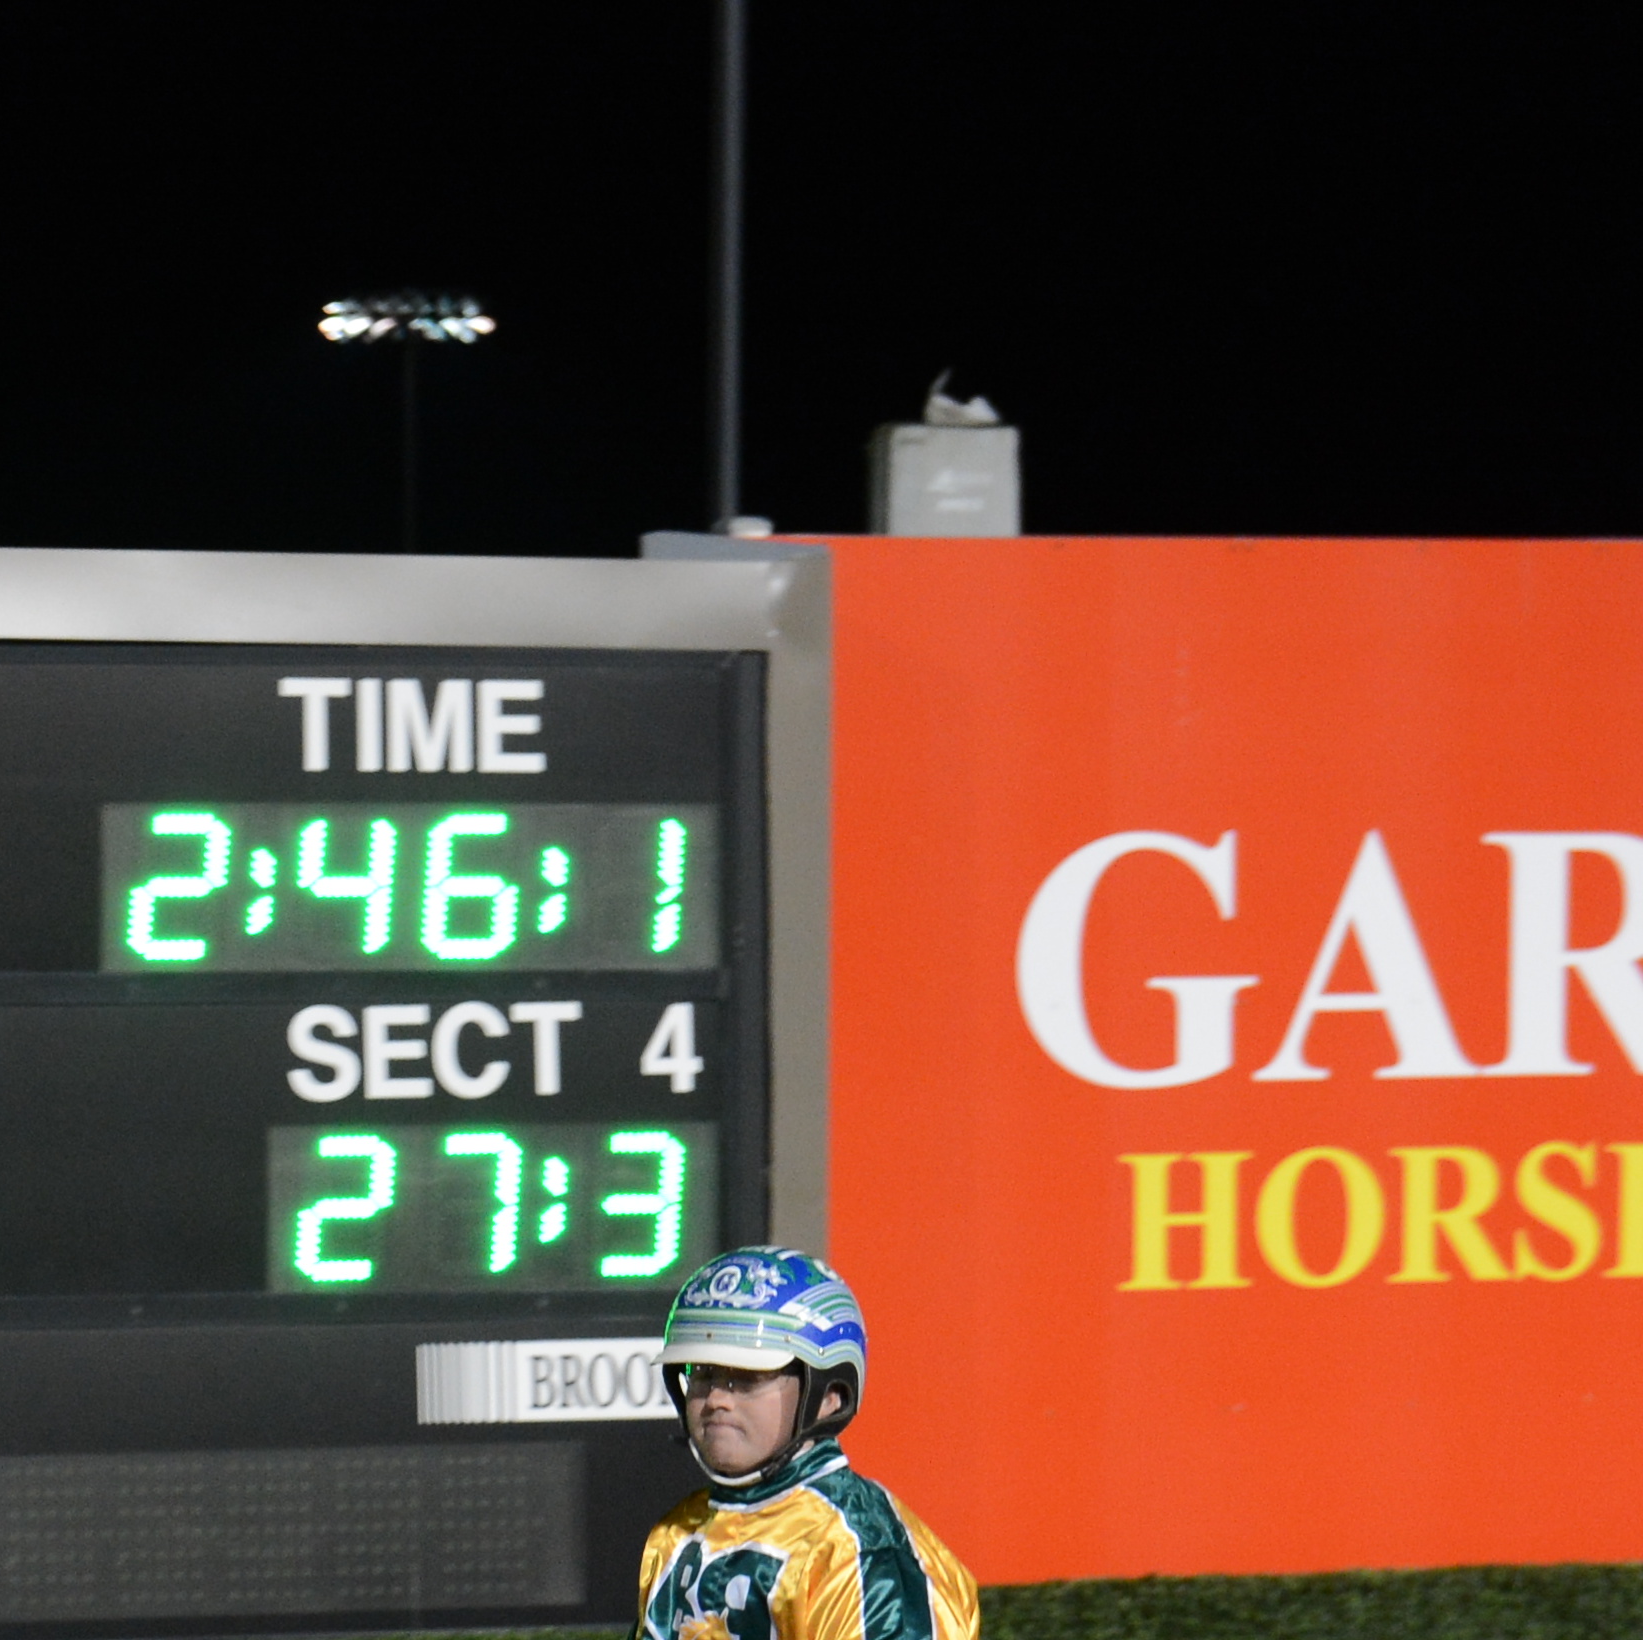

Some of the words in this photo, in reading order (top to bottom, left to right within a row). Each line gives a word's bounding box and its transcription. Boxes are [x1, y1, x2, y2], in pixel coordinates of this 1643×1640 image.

[278, 677, 545, 773] TIME
[288, 1001, 581, 1102] SECT
[641, 1003, 703, 1092] 4
[292, 1132, 686, 1283] 27:3
[529, 1353, 672, 1409] BROO
